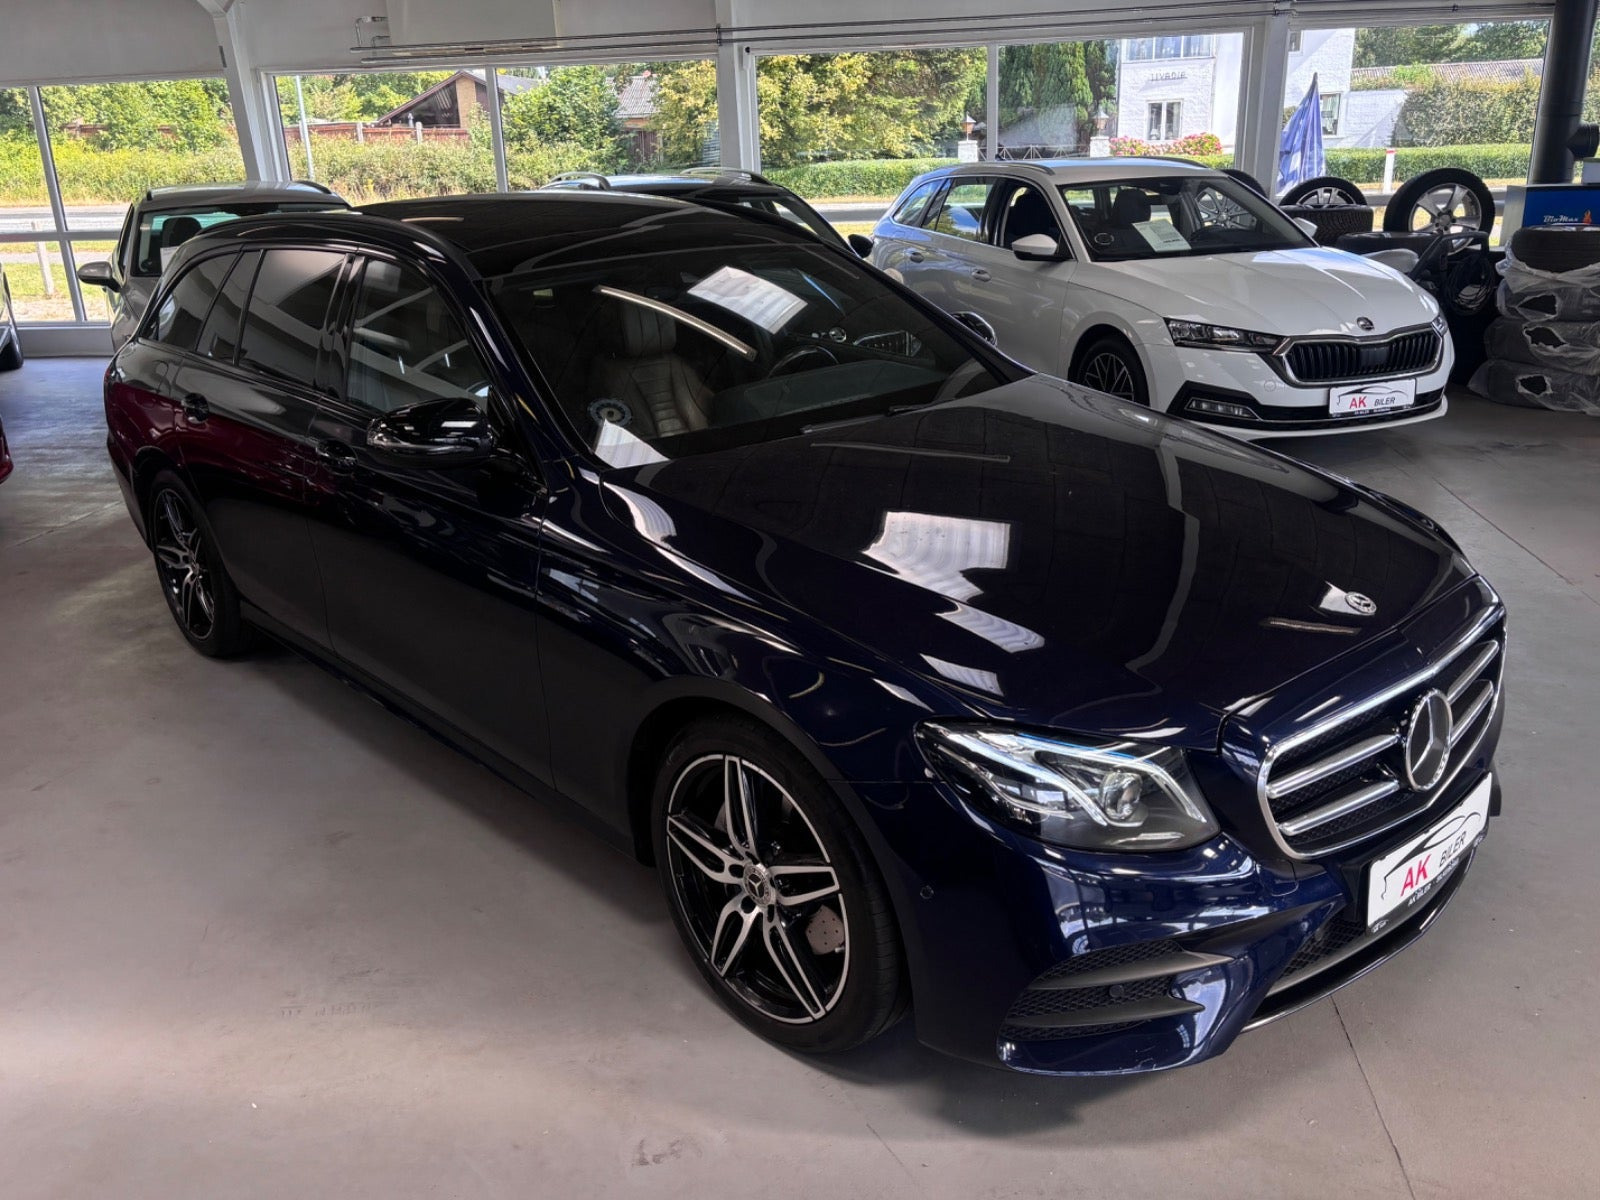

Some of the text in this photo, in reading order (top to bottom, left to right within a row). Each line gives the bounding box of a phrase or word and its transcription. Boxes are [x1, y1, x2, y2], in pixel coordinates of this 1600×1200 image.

[1349, 396, 1367, 409] AK
[1374, 396, 1396, 407] BILER
[1400, 853, 1432, 897] AK
[1439, 830, 1467, 868] BILER
